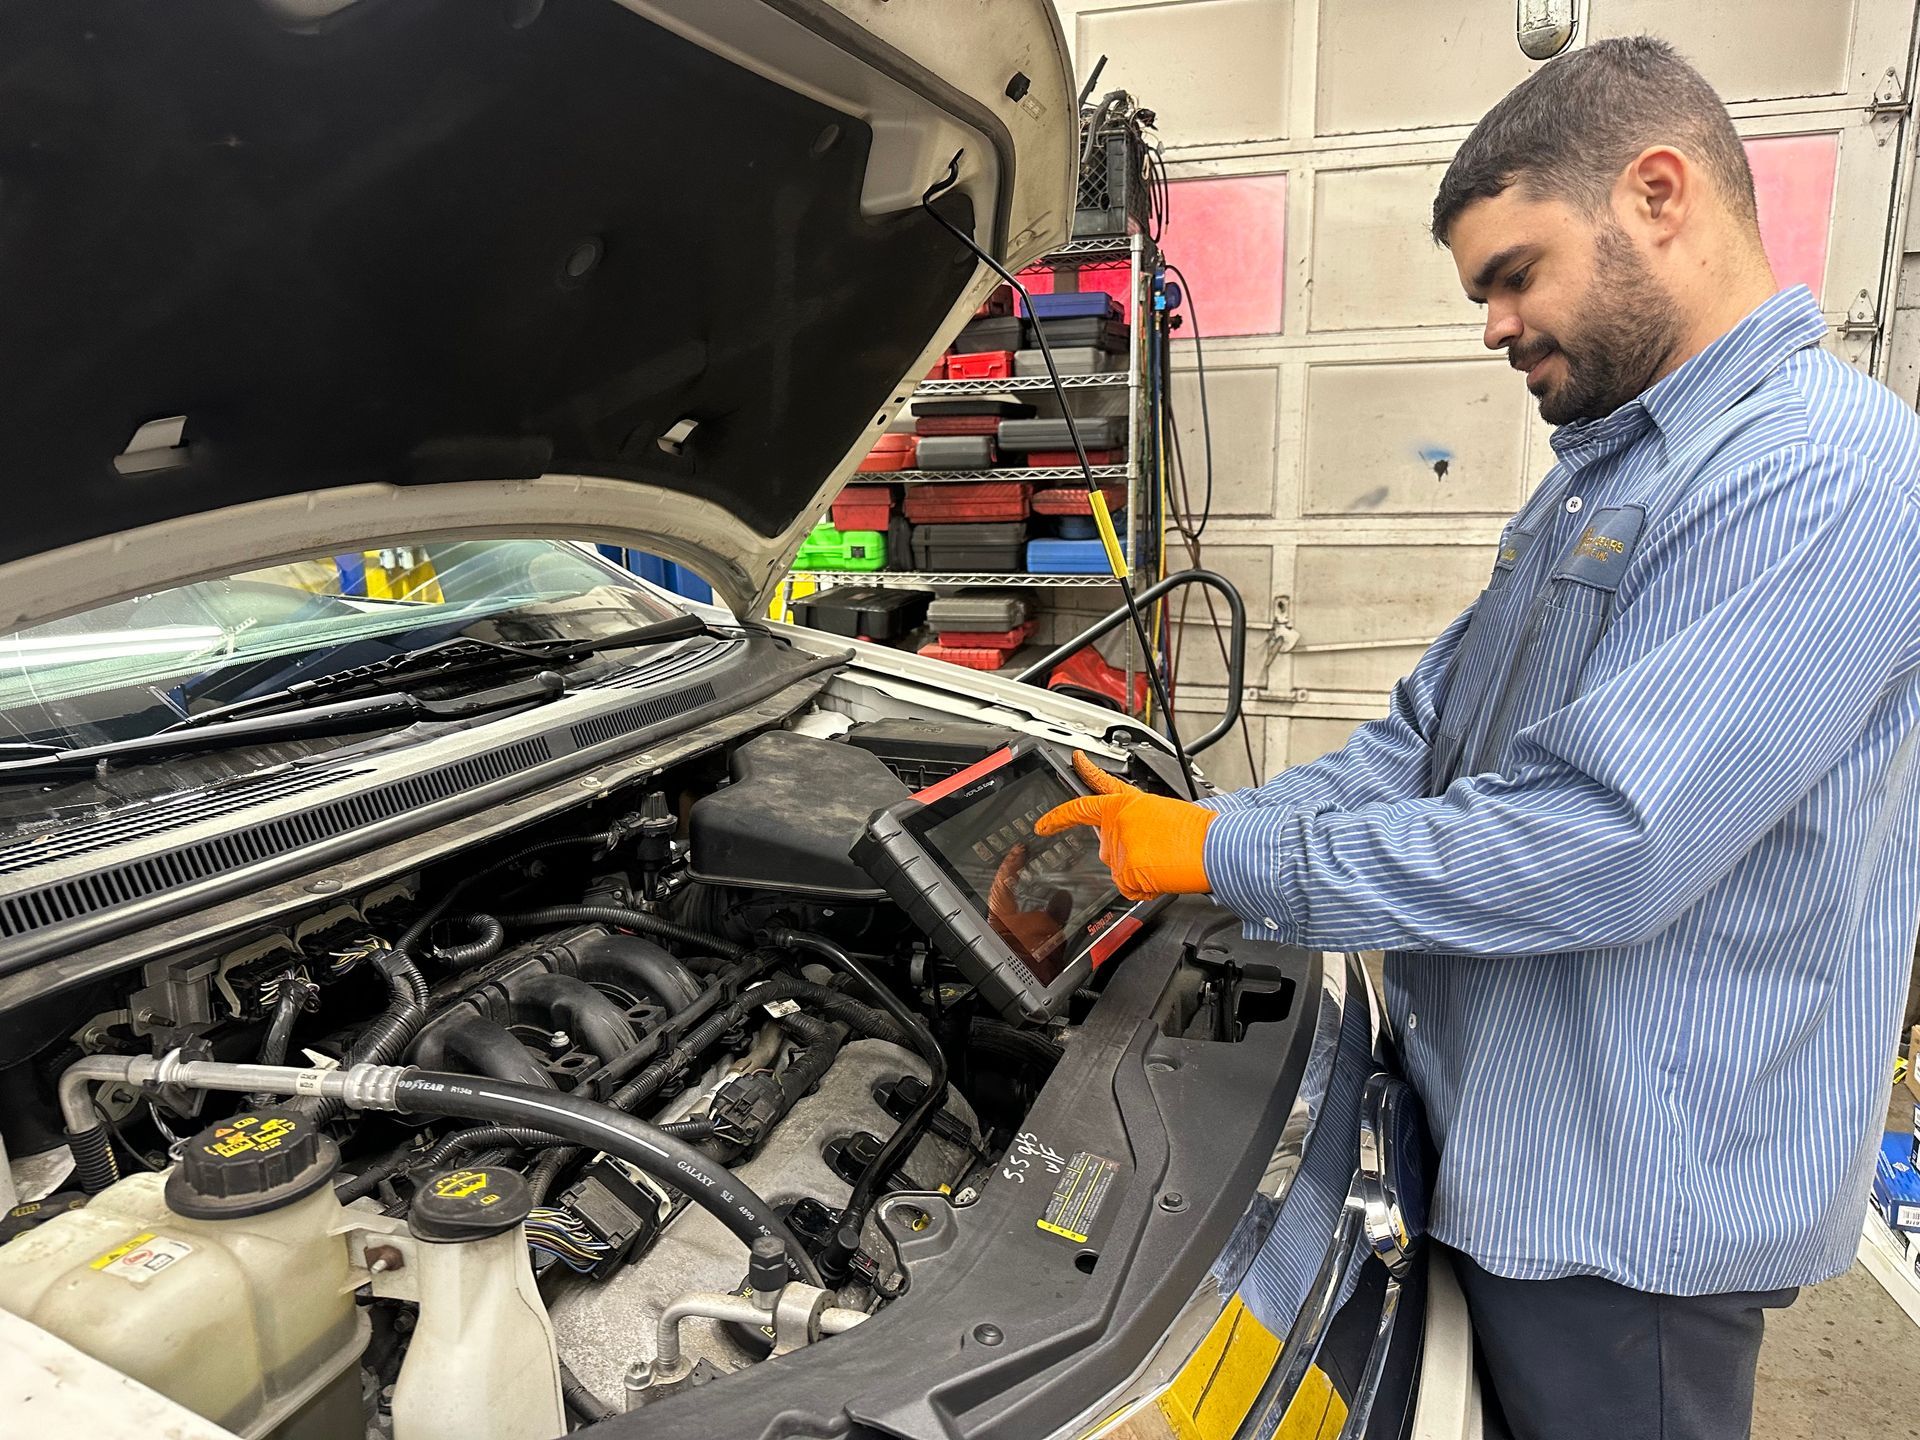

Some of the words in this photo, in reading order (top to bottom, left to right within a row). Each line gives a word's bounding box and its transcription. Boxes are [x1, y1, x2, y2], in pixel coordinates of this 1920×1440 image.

[399, 1079, 444, 1091] ODYEAR
[451, 1086, 472, 1095] R134a
[1003, 1155, 1030, 1183] 5.5
[677, 1160, 716, 1187] GALAXY
[738, 1206, 755, 1221] 4890
[758, 1225, 771, 1236] A/C
